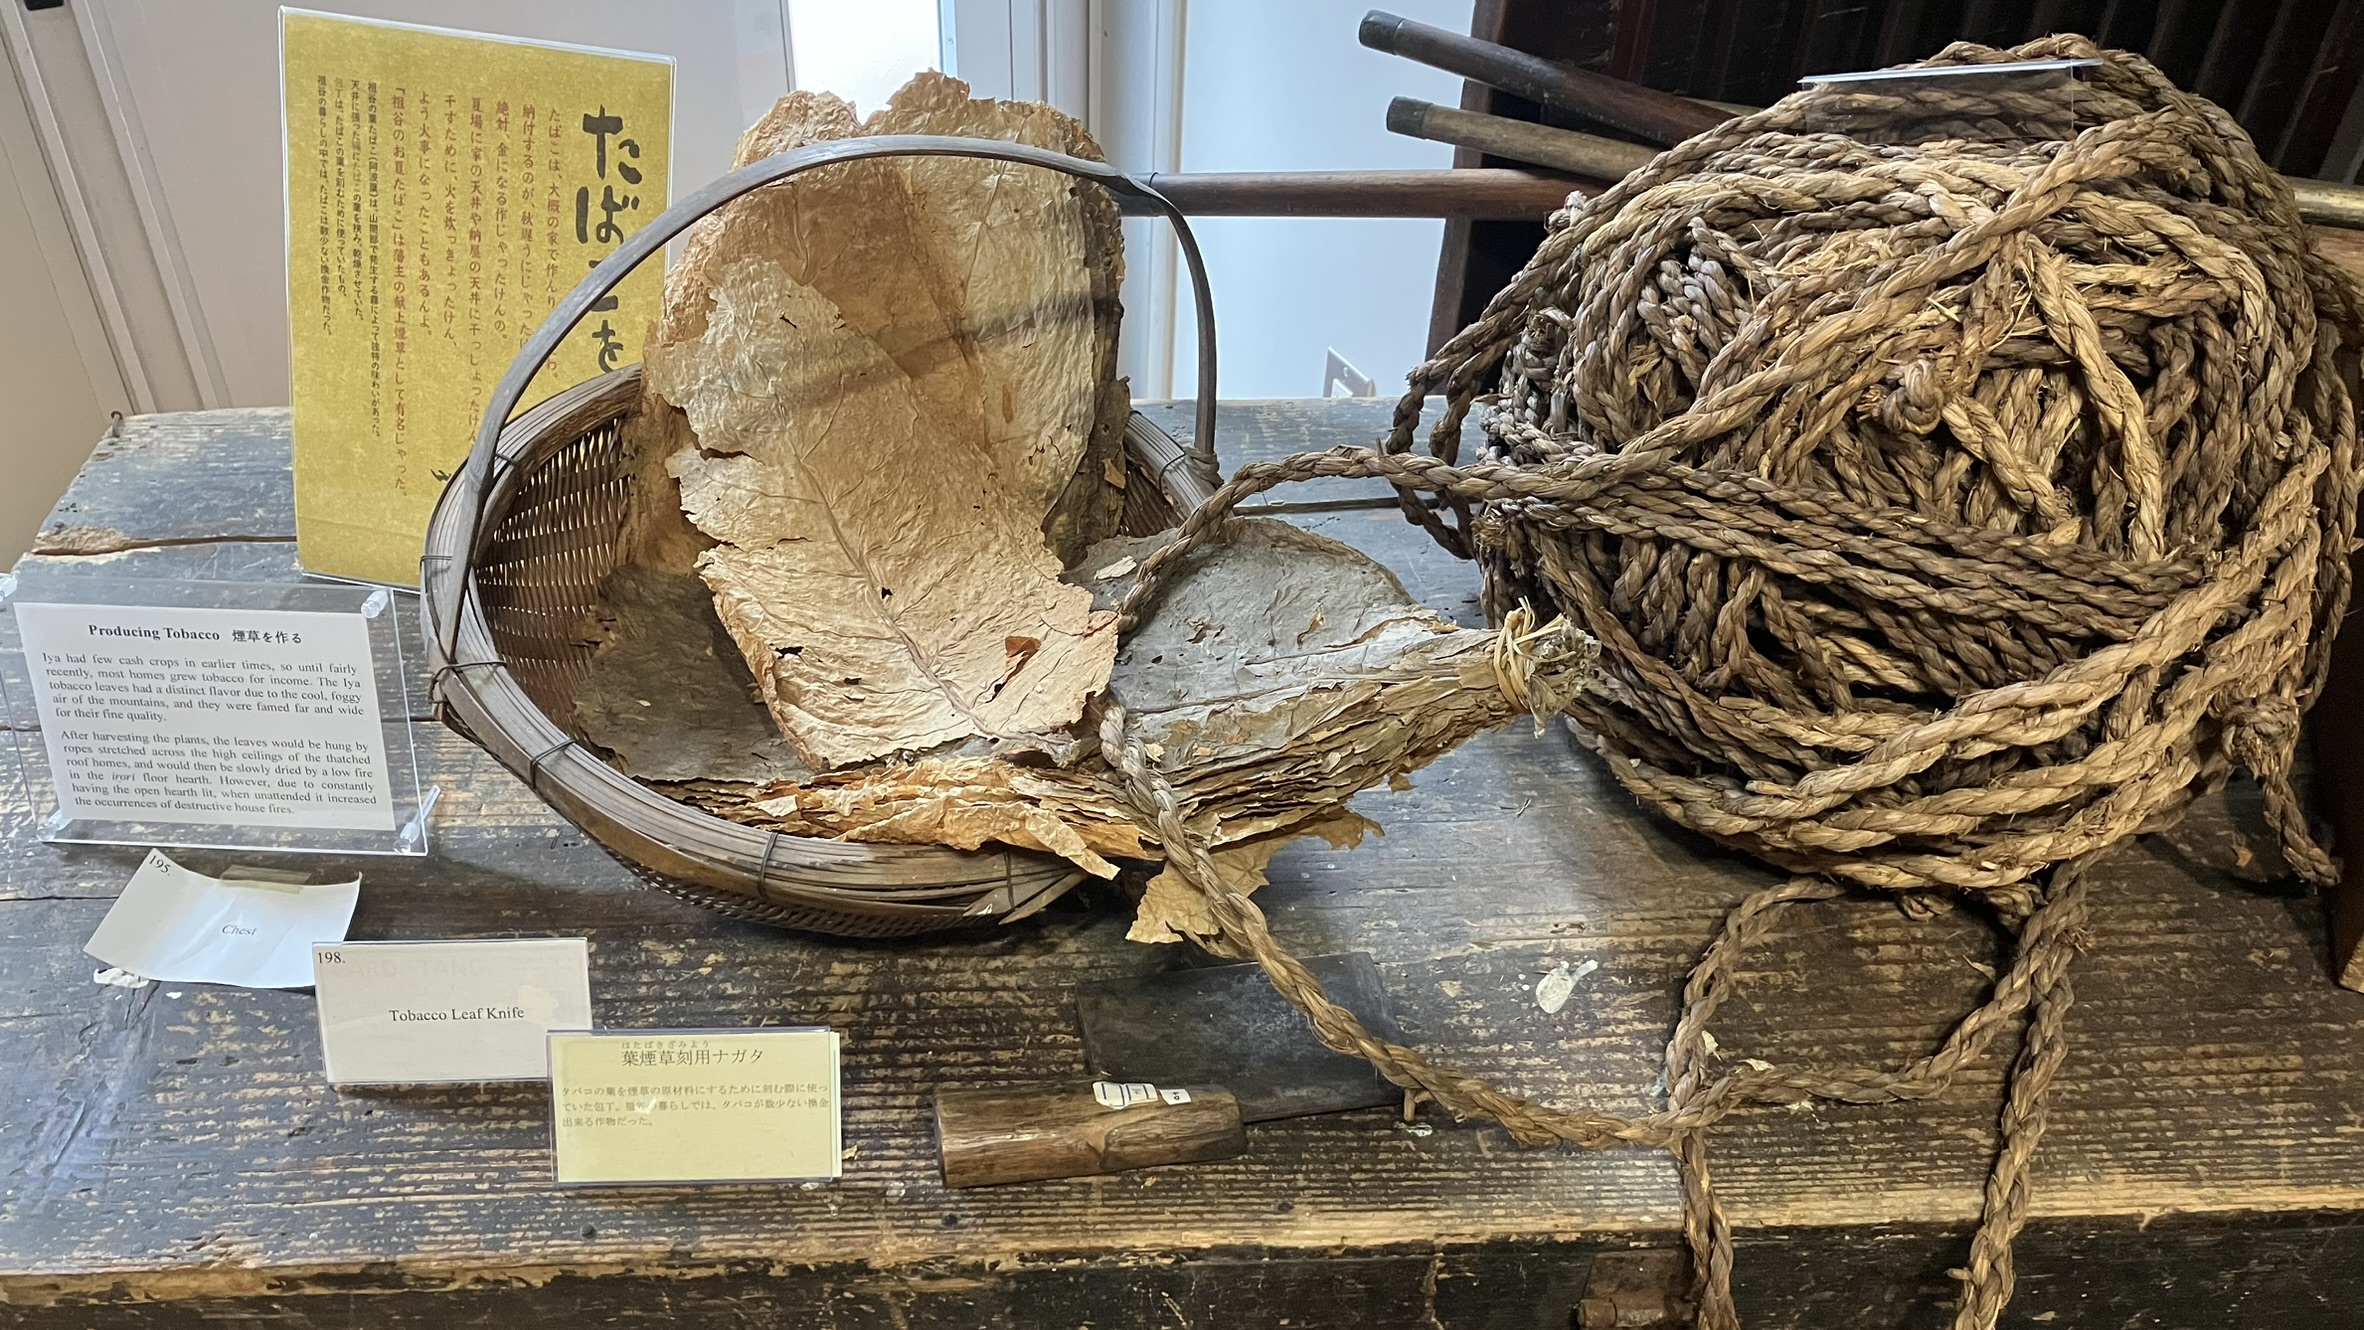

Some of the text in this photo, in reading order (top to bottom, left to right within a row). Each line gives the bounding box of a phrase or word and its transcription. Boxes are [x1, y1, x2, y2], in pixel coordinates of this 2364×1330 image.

[418, 91, 432, 336] よう火事になったこともあるんよ。
[88, 624, 220, 641] Producing Tobacco
[231, 629, 302, 644] 煙草を作る
[42, 652, 357, 676] Iya had few cash crops in earlier times, so until fairly
[45, 667, 361, 690] recently, most homes grew tobacco for income. The Iya
[49, 680, 362, 705] tobacco leaves had a distinct flavor due to the cool, foggy
[52, 693, 364, 716] air of the mountains, and they were famed far and wide
[55, 707, 167, 723] for their fine quality.
[61, 730, 368, 754] After harvesting the plants, the leaves would be hung by
[63, 745, 371, 765] ropes stretched across the high ceilings of the thatched
[66, 757, 373, 778] roof homes, and would then be slowly dried by a low fire
[69, 769, 374, 794] in the irori floor hearth. However, due to constantly
[71, 782, 377, 804] having the open hearth lit, when unattended it increased
[74, 796, 295, 814] the occurrences of destructive house fires.
[149, 855, 171, 877] 195.
[222, 923, 258, 937] Chest
[317, 950, 346, 965] 198.
[389, 1006, 525, 1022] Tobacco Leaf Knife
[621, 1049, 765, 1067] 葉煙草刻用ナガタ
